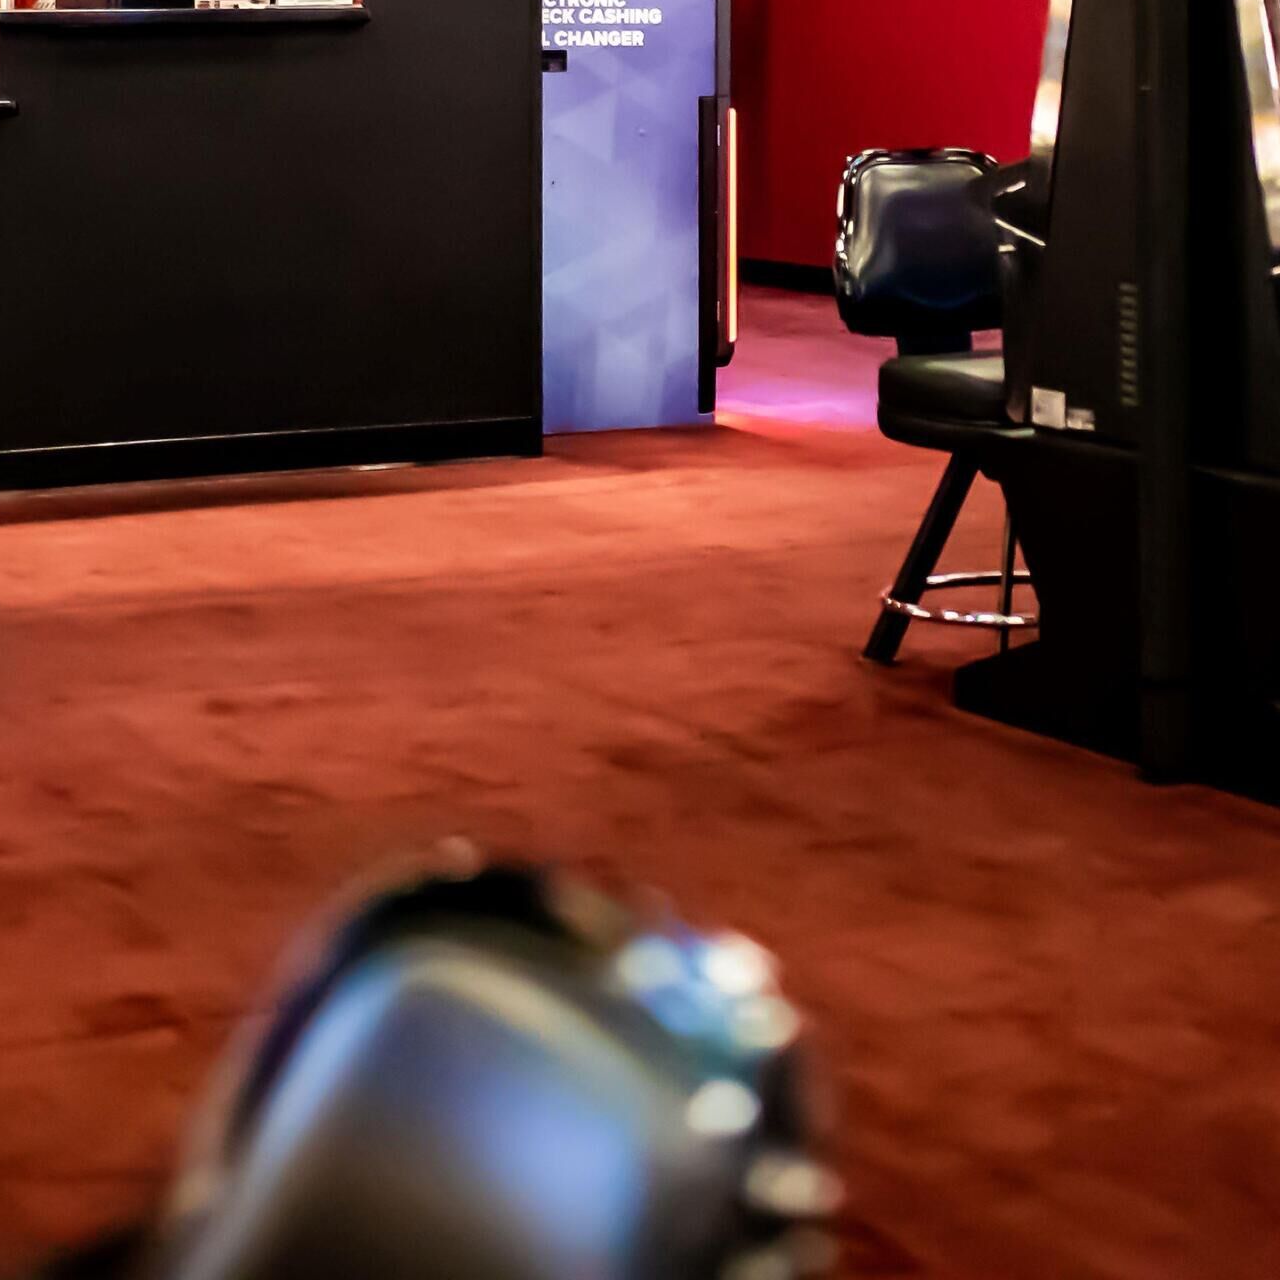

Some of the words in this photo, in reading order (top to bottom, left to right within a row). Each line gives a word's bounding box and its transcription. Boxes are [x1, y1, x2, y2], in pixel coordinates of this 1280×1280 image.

[542, 8, 575, 25] ECK
[578, 8, 663, 25] CASHING
[554, 30, 645, 47] CHANGER
